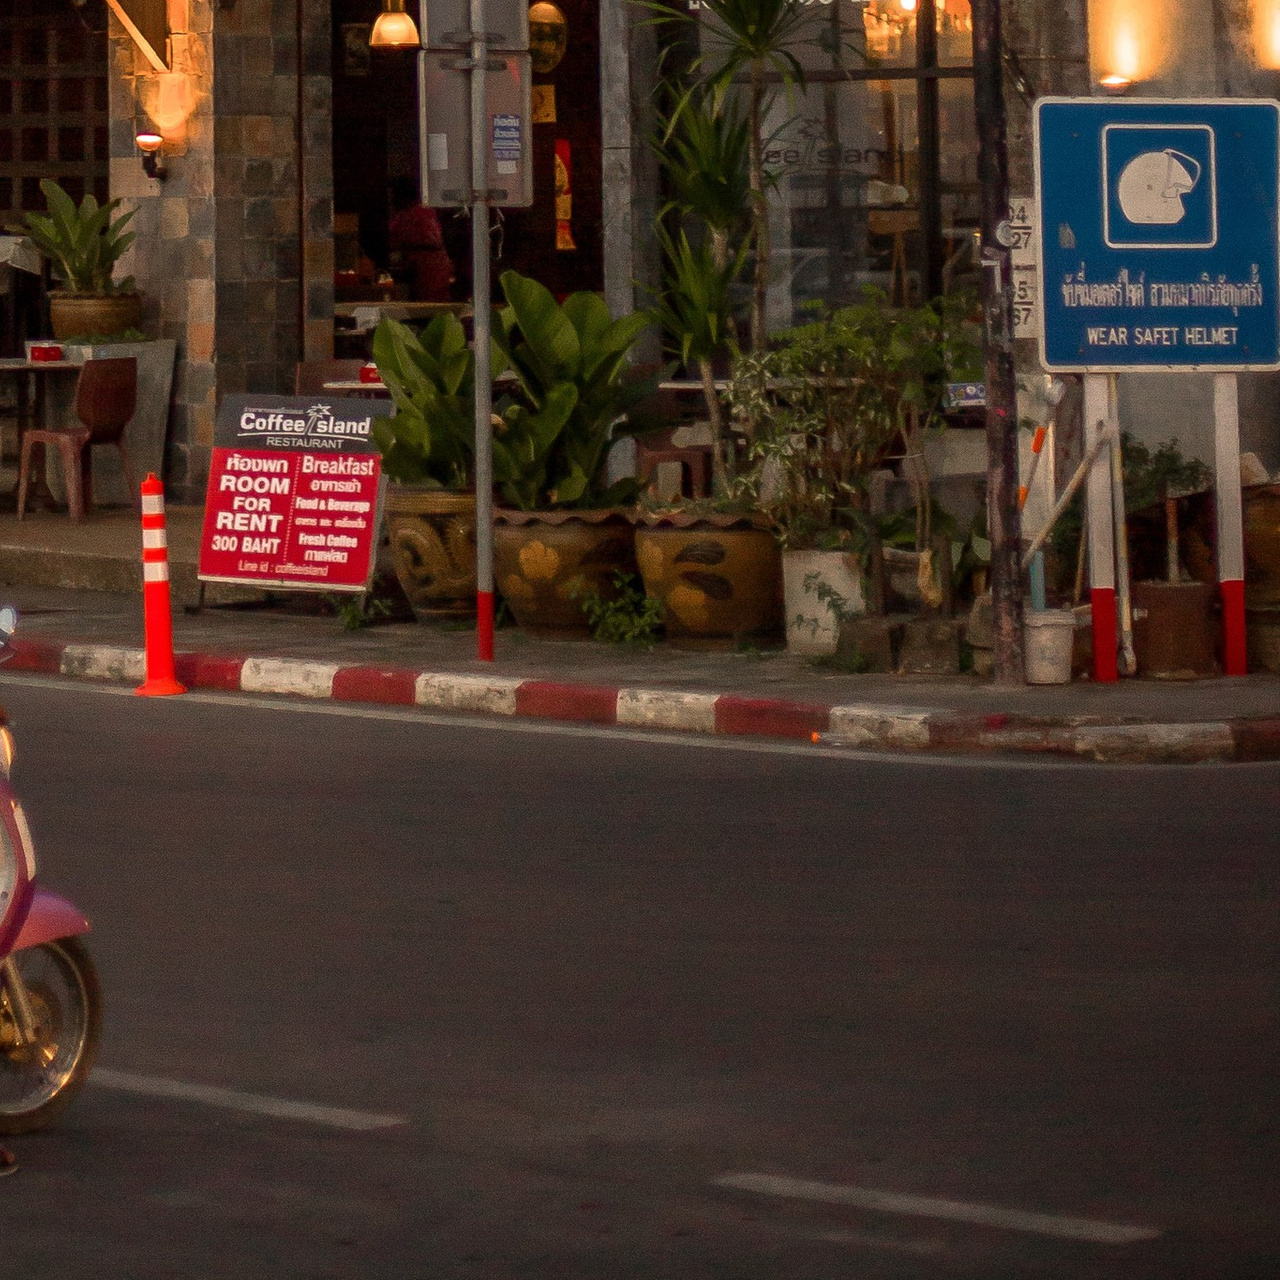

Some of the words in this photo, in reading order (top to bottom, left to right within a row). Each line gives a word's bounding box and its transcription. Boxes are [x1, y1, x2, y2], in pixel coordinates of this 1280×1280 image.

[1086, 326, 1128, 346] WEAR
[1184, 326, 1239, 346] HELMET
[240, 412, 305, 431] Coffee
[266, 437, 344, 450] RESTAURANT
[302, 455, 374, 476] Breakfast
[220, 475, 290, 495] ROOM
[233, 496, 271, 512] FOR
[216, 512, 284, 533] RENT
[211, 535, 238, 552] 300
[241, 537, 281, 555] BAHT
[326, 534, 358, 549] Coffee
